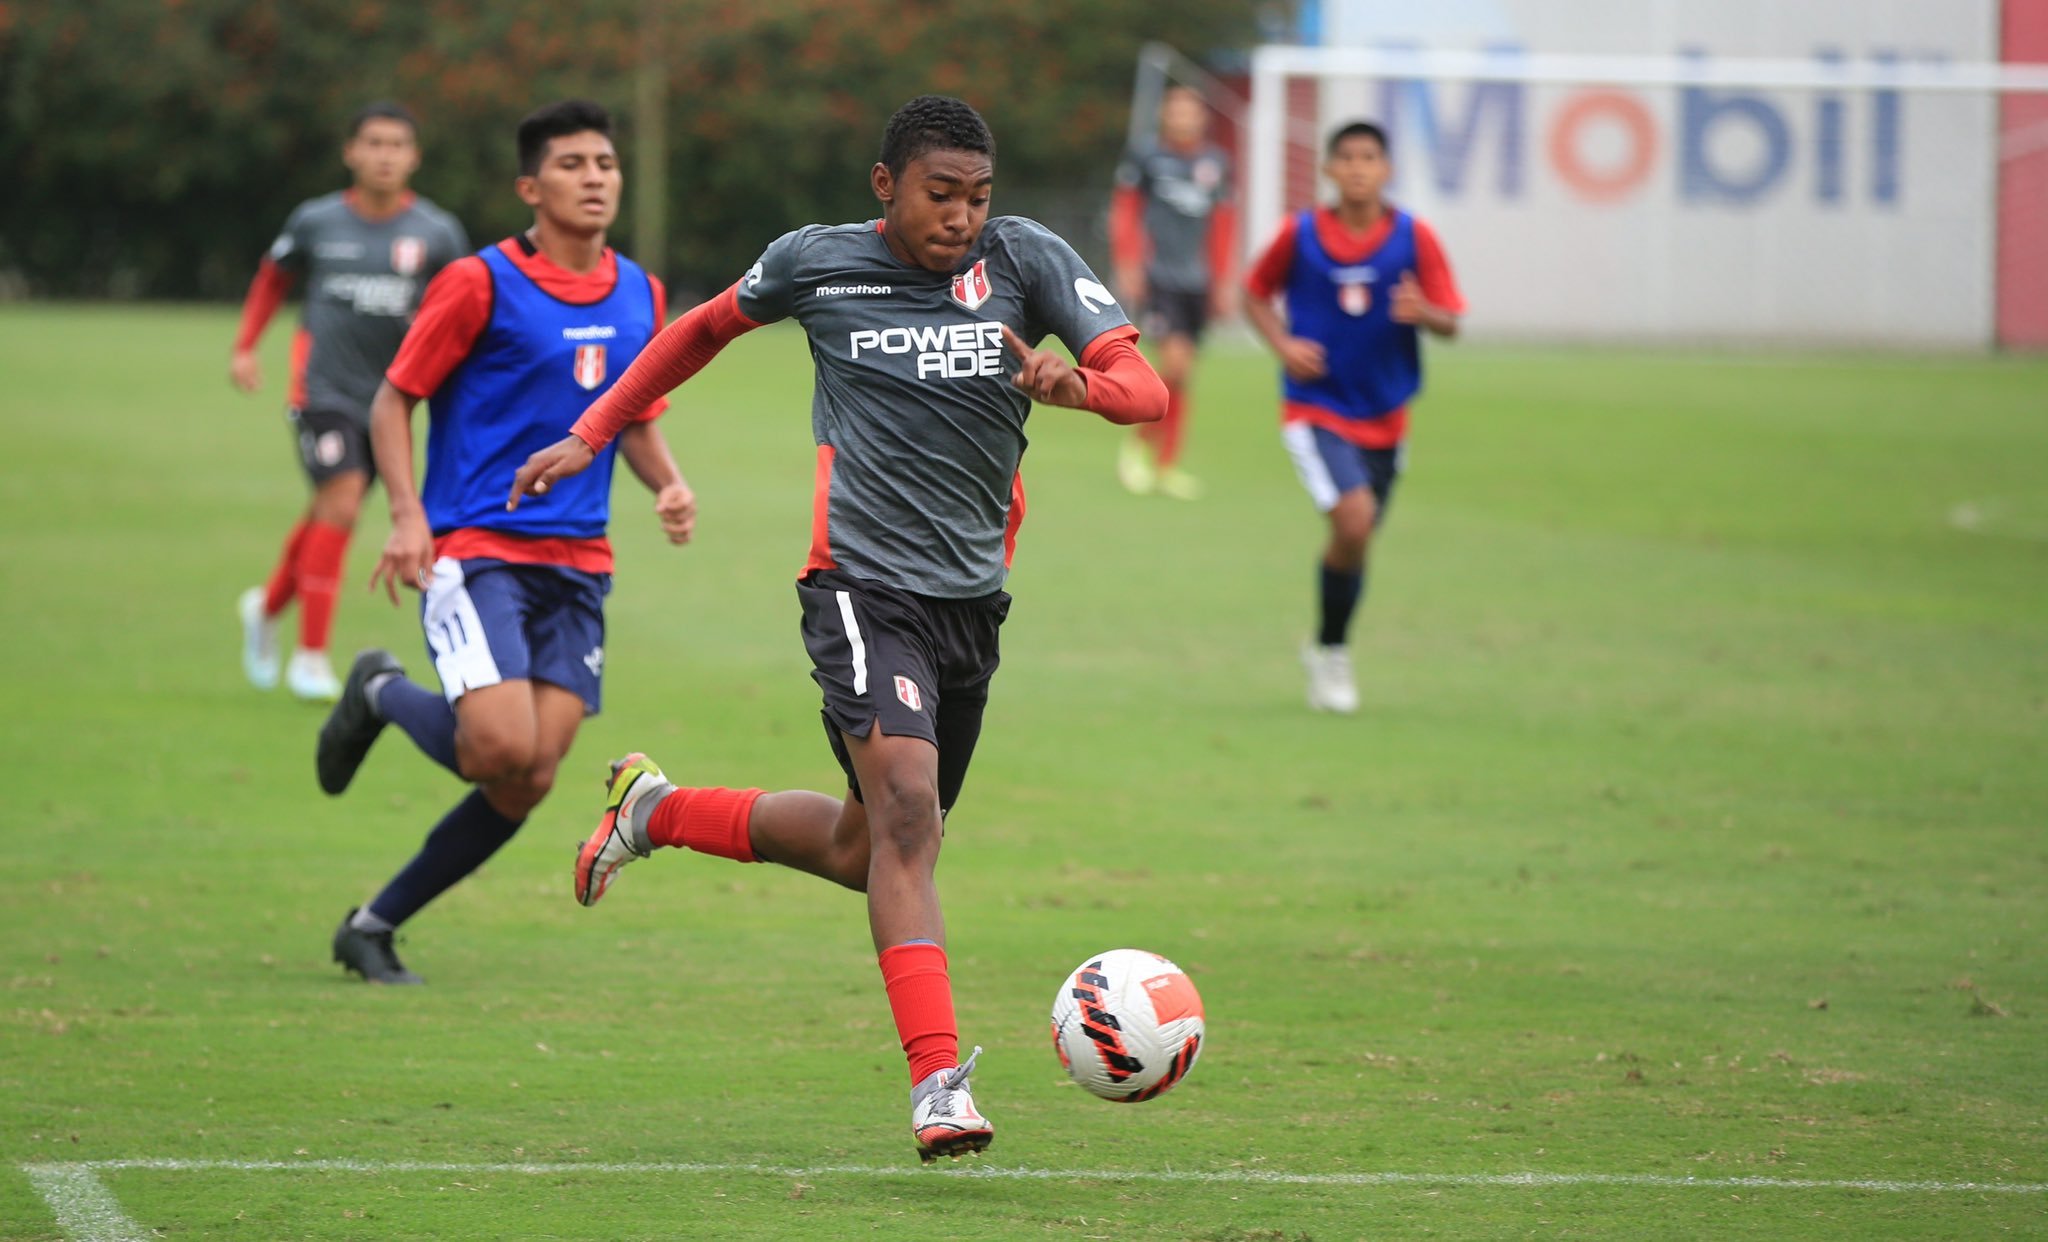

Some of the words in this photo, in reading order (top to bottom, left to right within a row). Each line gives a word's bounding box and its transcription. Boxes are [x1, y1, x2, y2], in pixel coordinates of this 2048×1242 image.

[1377, 43, 1899, 205] Mobil
[815, 284, 891, 297] marathon
[849, 321, 1004, 360] POWER
[441, 611, 467, 653] 11
